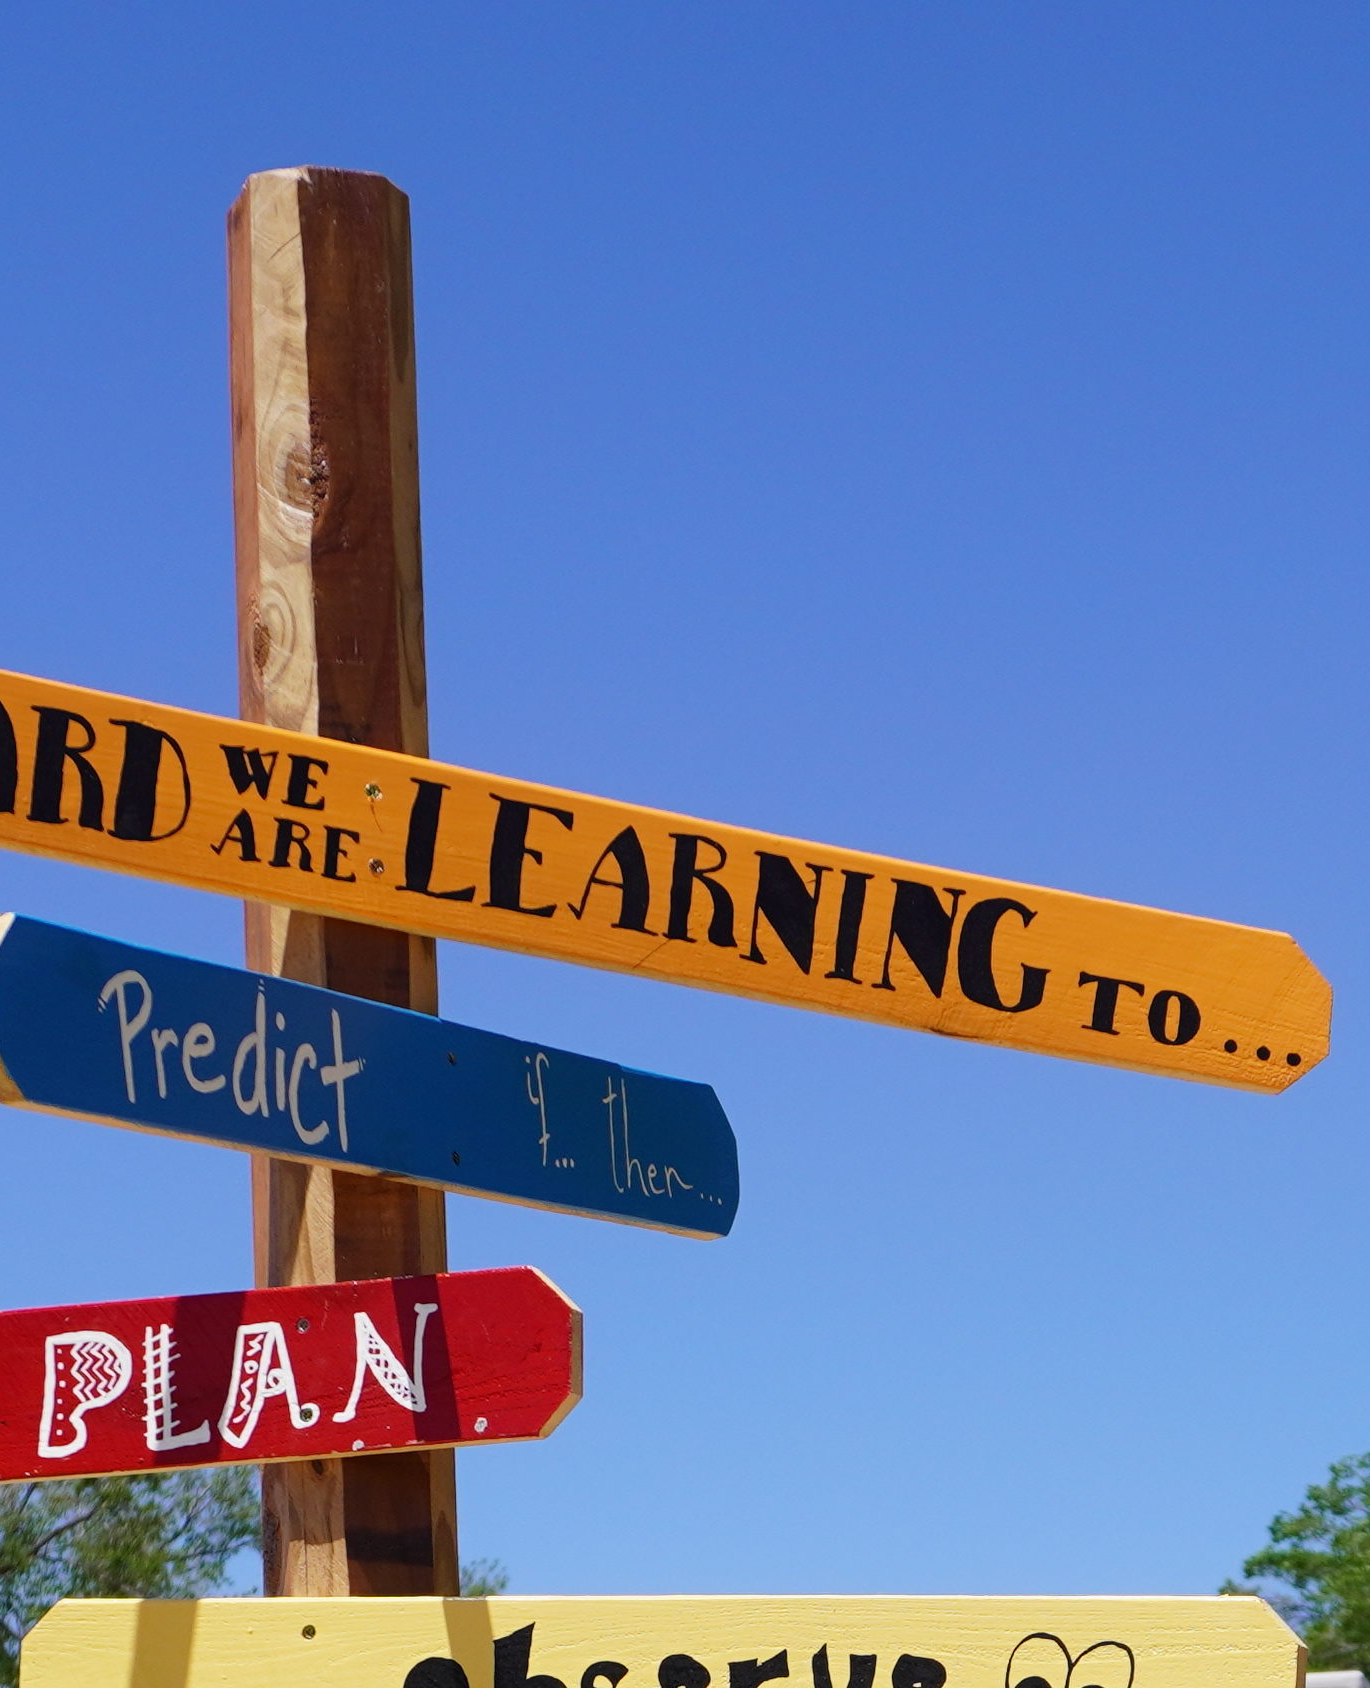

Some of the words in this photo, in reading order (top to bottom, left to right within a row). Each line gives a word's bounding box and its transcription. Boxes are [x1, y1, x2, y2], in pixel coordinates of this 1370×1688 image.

[210, 808, 360, 883] ARE
[220, 744, 329, 811] WE
[396, 777, 1051, 1014] LEARNING
[97, 970, 365, 1152] Predict
[38, 1303, 438, 1458] PLAN
